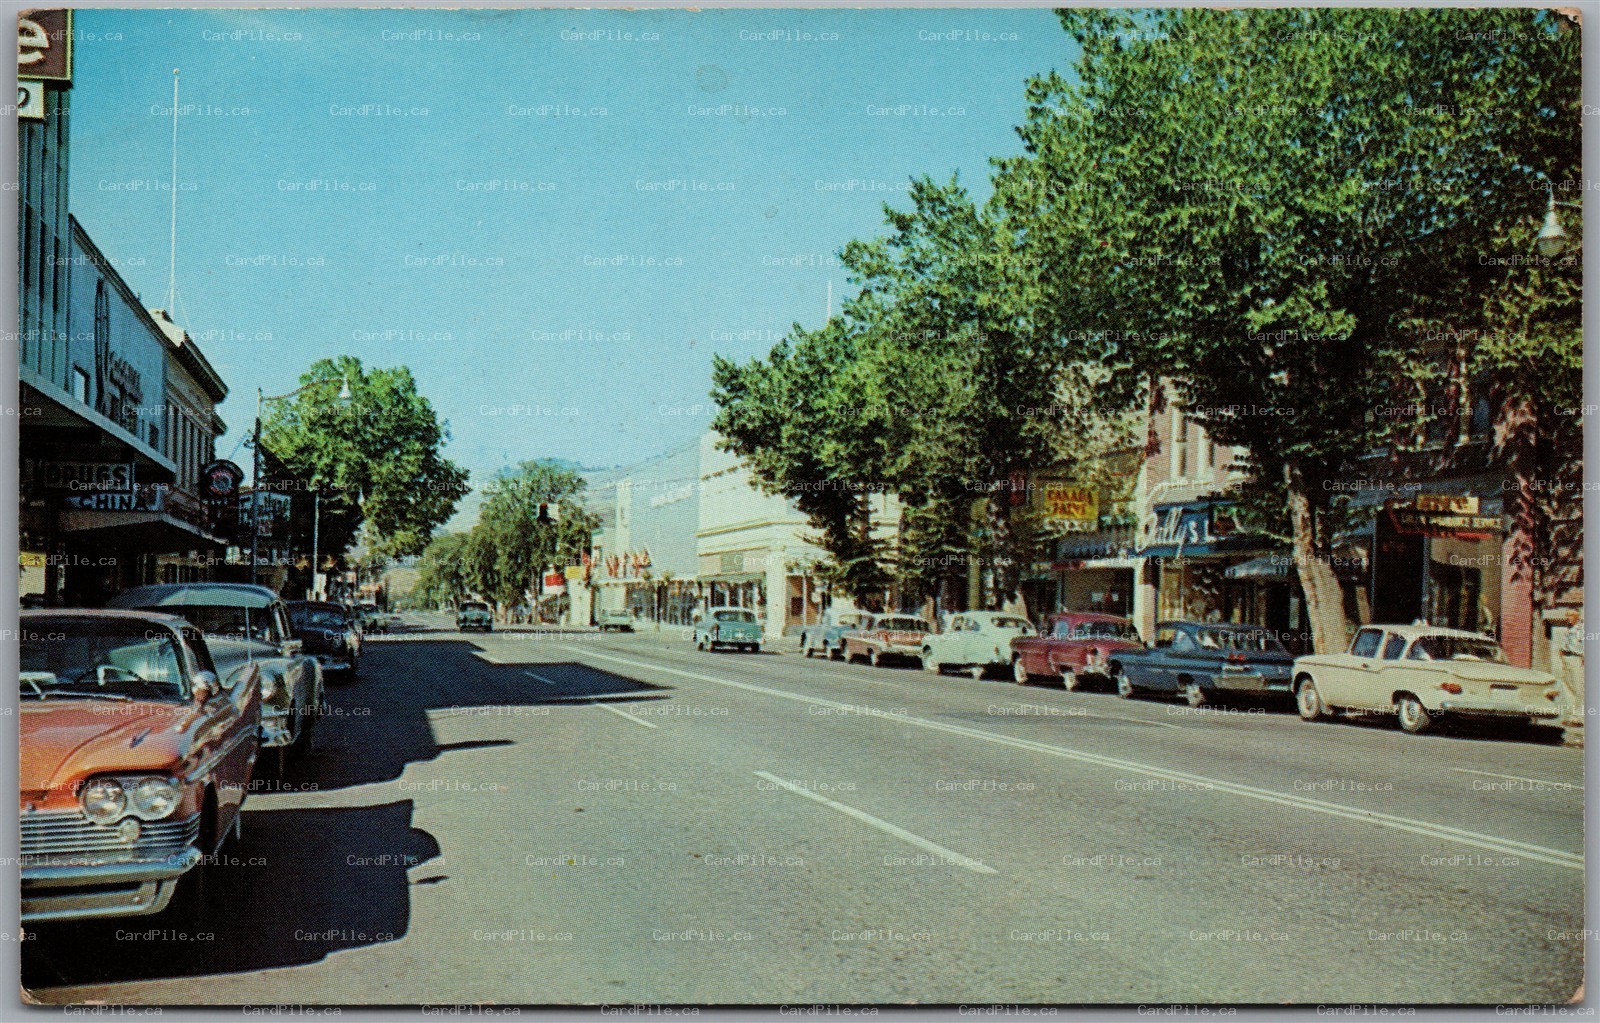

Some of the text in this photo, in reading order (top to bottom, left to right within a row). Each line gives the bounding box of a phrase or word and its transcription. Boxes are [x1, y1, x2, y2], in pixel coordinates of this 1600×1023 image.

[46, 464, 127, 486] DRUGS
[79, 493, 149, 512] CHINA
[1047, 488, 1093, 505] CANADA
